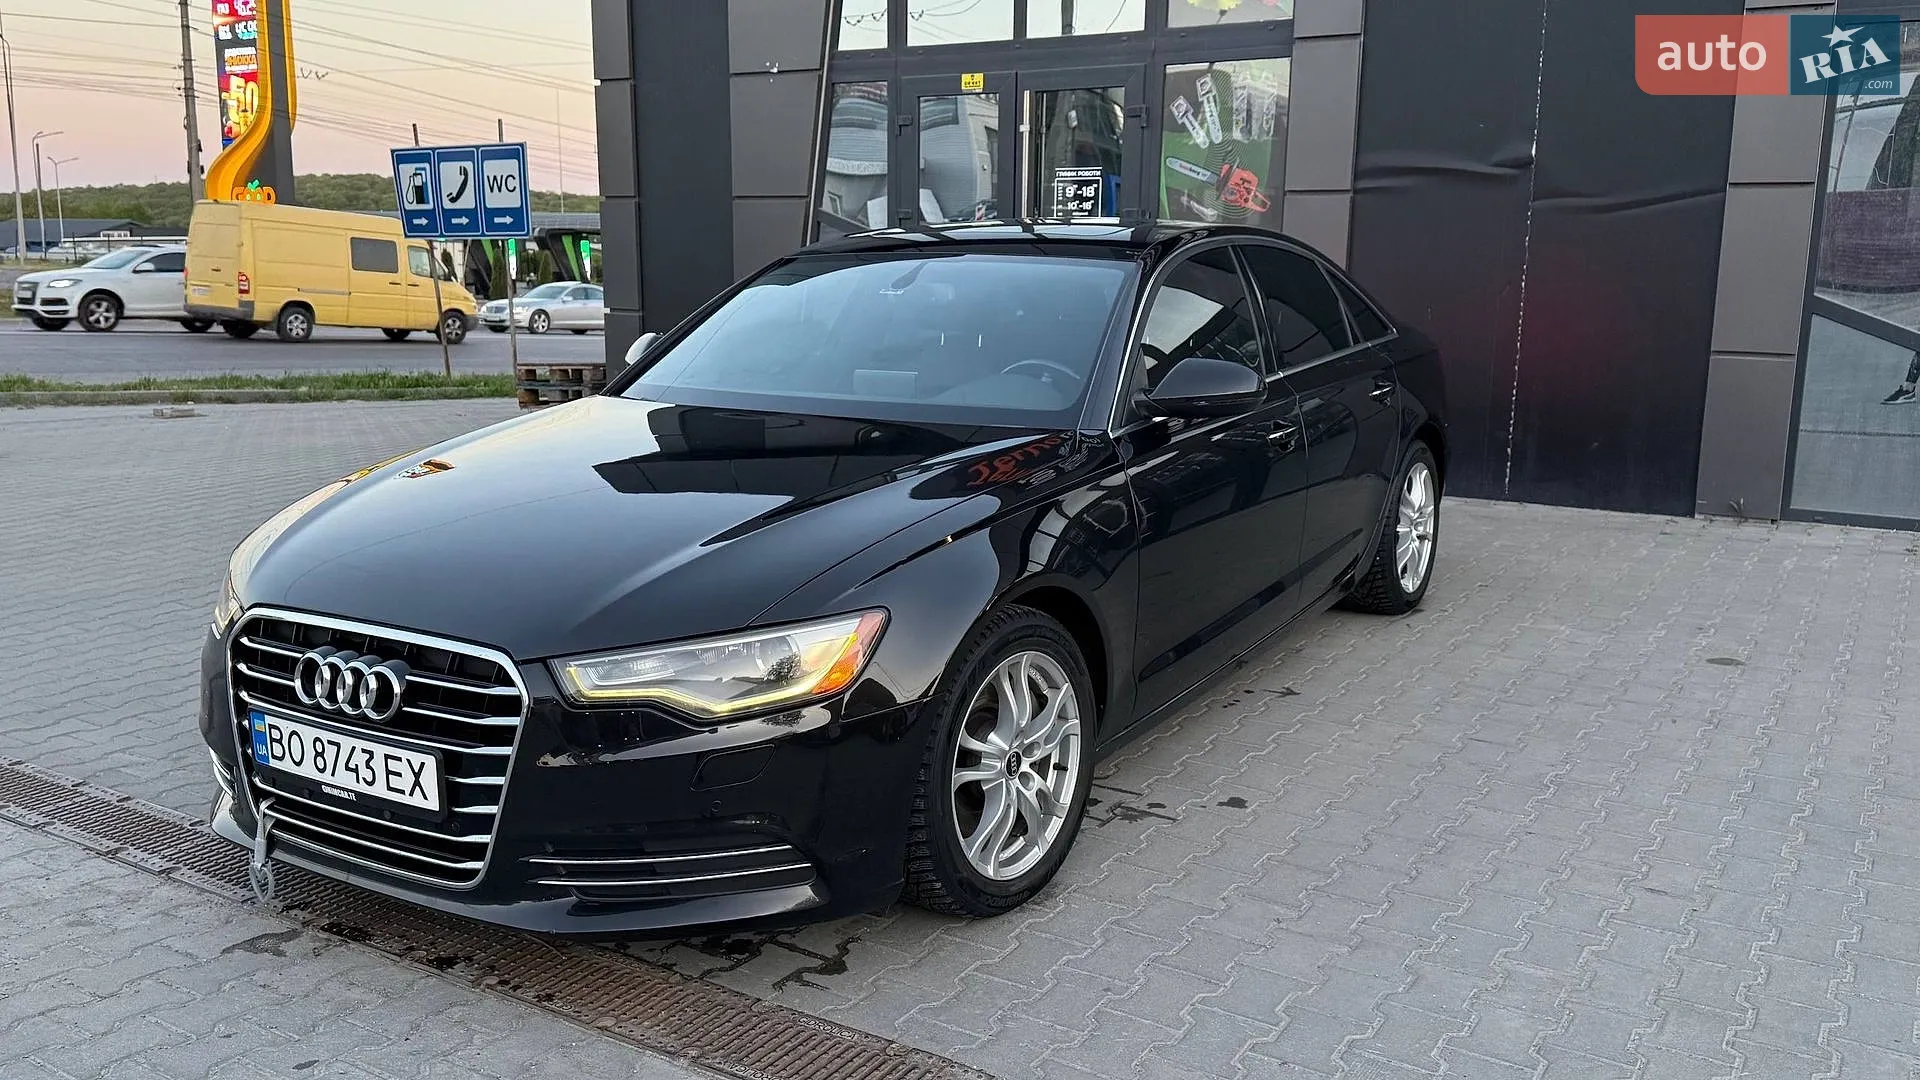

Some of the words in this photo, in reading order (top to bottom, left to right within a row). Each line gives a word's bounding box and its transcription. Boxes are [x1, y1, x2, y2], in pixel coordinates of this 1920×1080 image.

[487, 174, 517, 193] WC
[256, 743, 268, 757] UA
[268, 723, 305, 767] BO
[312, 736, 377, 787] 8743
[383, 753, 429, 801] EX
